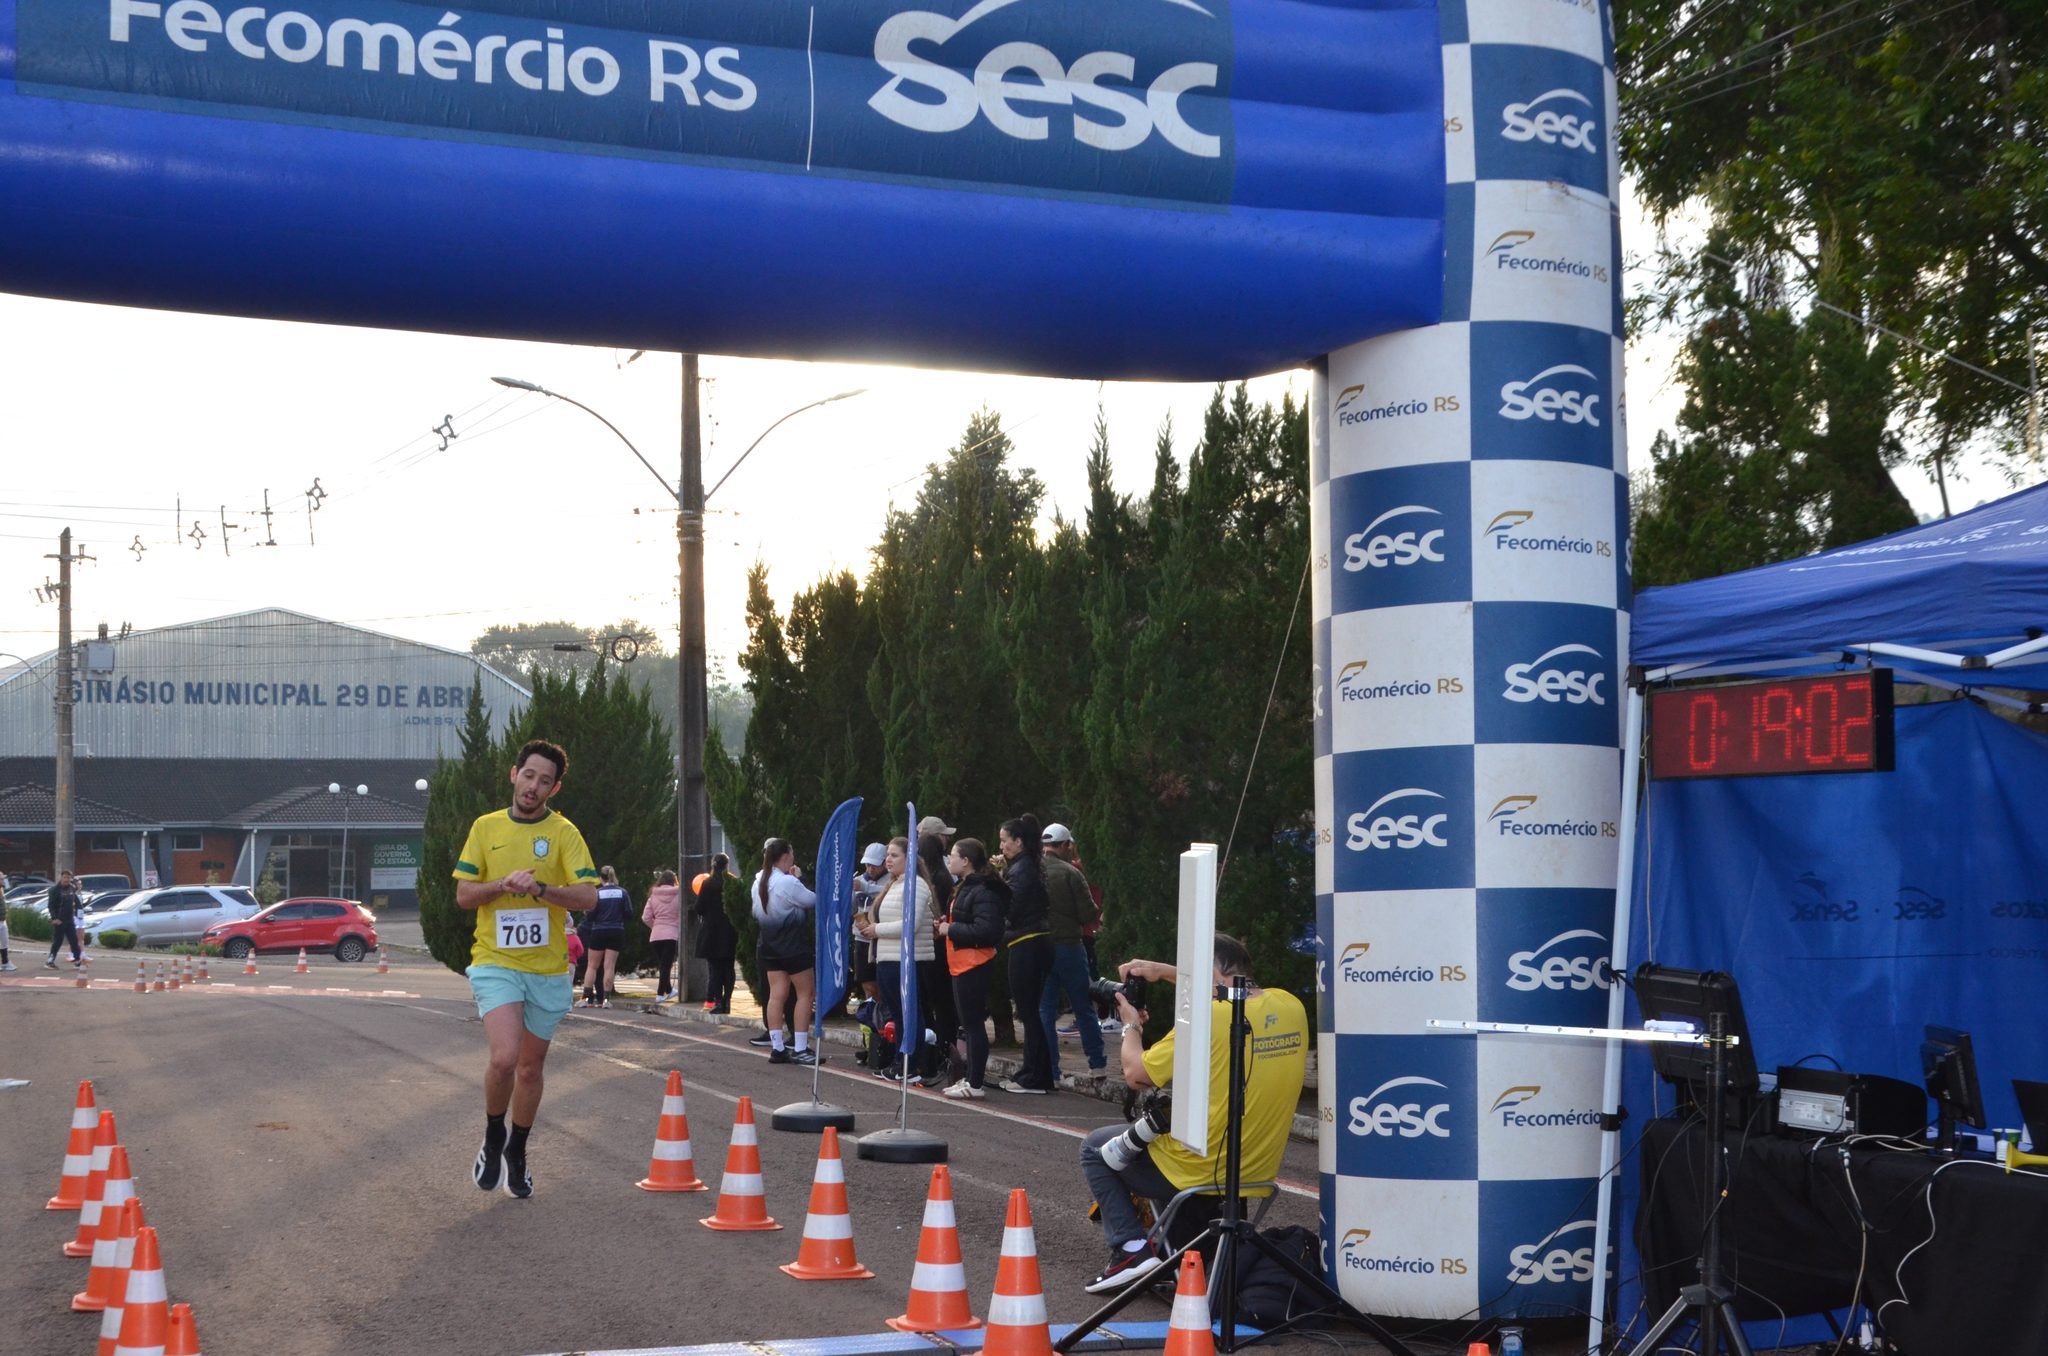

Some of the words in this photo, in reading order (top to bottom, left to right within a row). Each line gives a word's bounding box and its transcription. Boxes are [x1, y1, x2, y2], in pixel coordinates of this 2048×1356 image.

[109, 0, 620, 97] Fecomércio
[648, 40, 758, 112] RS
[867, 8, 1221, 158] Sesc
[1500, 102, 1596, 153] Sesc
[1498, 253, 1591, 279] Fecomércio
[1593, 265, 1608, 283] RS
[1338, 400, 1428, 427] Fecomércio
[1433, 395, 1460, 412] RS
[1498, 380, 1600, 428] Sesc
[1343, 528, 1445, 572] Sesc
[1496, 535, 1593, 555] Fecomércio
[1596, 540, 1612, 558] RS
[72, 675, 175, 705] GINÁSIO
[184, 682, 327, 706] MUNICIPAL
[336, 684, 369, 707] 29
[376, 684, 409, 708] DE
[1341, 680, 1431, 703] Fecomércio
[1436, 677, 1464, 695] RS
[1502, 663, 1605, 705] Sesc
[1688, 679, 1873, 770] 0:19:02
[1345, 813, 1448, 851] Sesc
[1500, 819, 1597, 836] Fecomércio
[1600, 822, 1617, 839] RS
[502, 923, 542, 946] 708
[1344, 965, 1434, 983] Fecomércio
[1440, 965, 1467, 982] RS
[1505, 951, 1610, 991] Sesc
[1348, 1096, 1450, 1138] Sesc
[1503, 1109, 1601, 1127] Fecomércio
[1345, 1252, 1434, 1274] Fecomércio
[1440, 1258, 1468, 1275] RS
